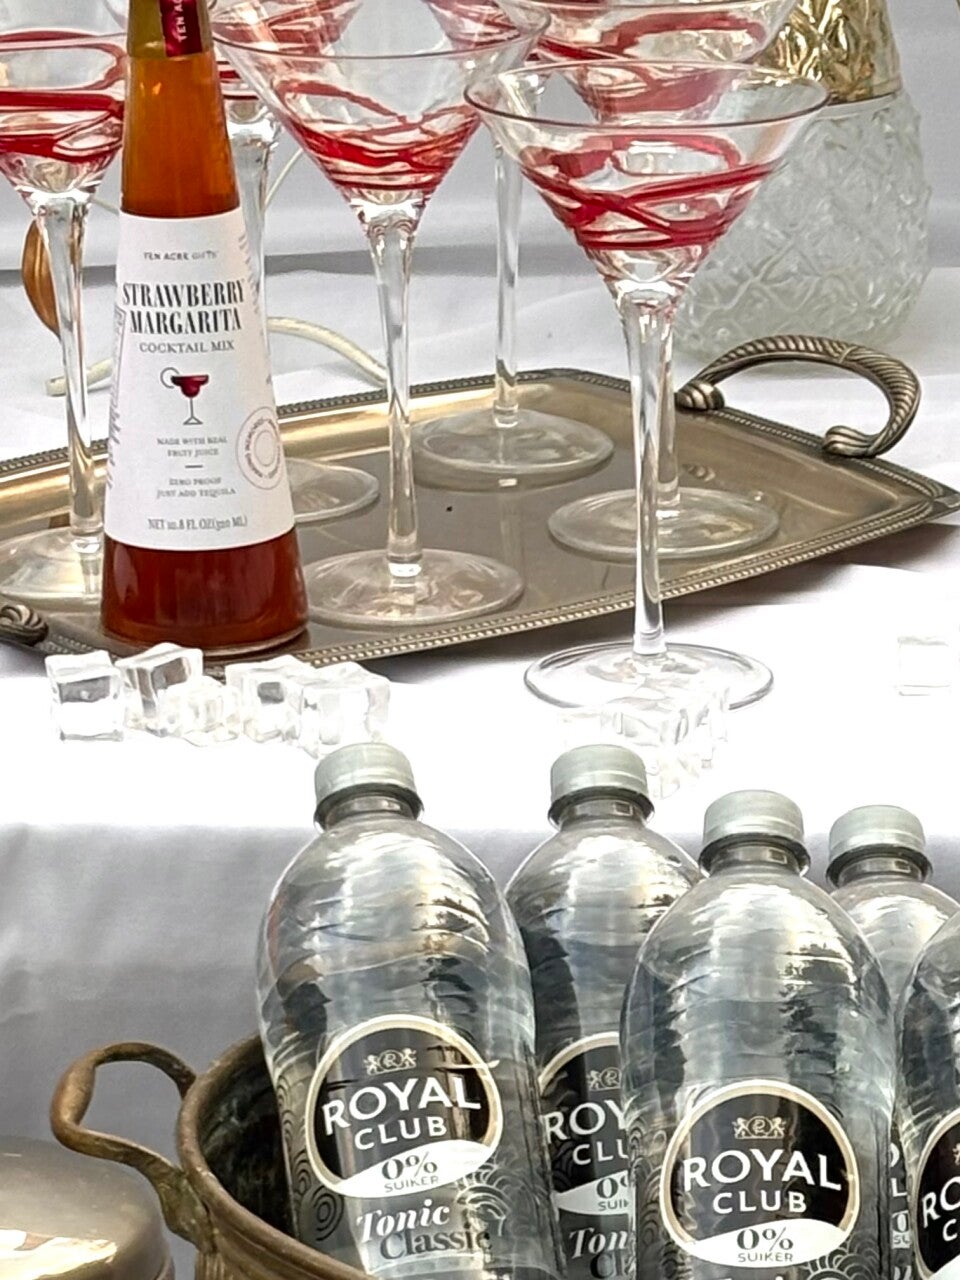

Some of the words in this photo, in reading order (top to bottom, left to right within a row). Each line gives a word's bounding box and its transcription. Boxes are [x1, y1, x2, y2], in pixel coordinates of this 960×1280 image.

[122, 280, 244, 308] STRAWBERRY
[130, 307, 242, 334] MARGARITA
[139, 341, 208, 354] COCKTAIL
[211, 339, 235, 352] MIX
[147, 518, 165, 530] NET
[322, 1076, 481, 1135] ROYAL
[354, 1115, 447, 1150] CLUB
[542, 1099, 632, 1144] ROY
[381, 1151, 438, 1181] 0%
[683, 1148, 842, 1193] ROYAL
[384, 1175, 439, 1193] SUIKER
[713, 1190, 808, 1214] CLUB
[356, 1199, 450, 1243] Tonic
[381, 1221, 492, 1260] Classic
[569, 1227, 629, 1259] Ton
[737, 1227, 794, 1252] 0%
[737, 1252, 794, 1263] SUIKER
